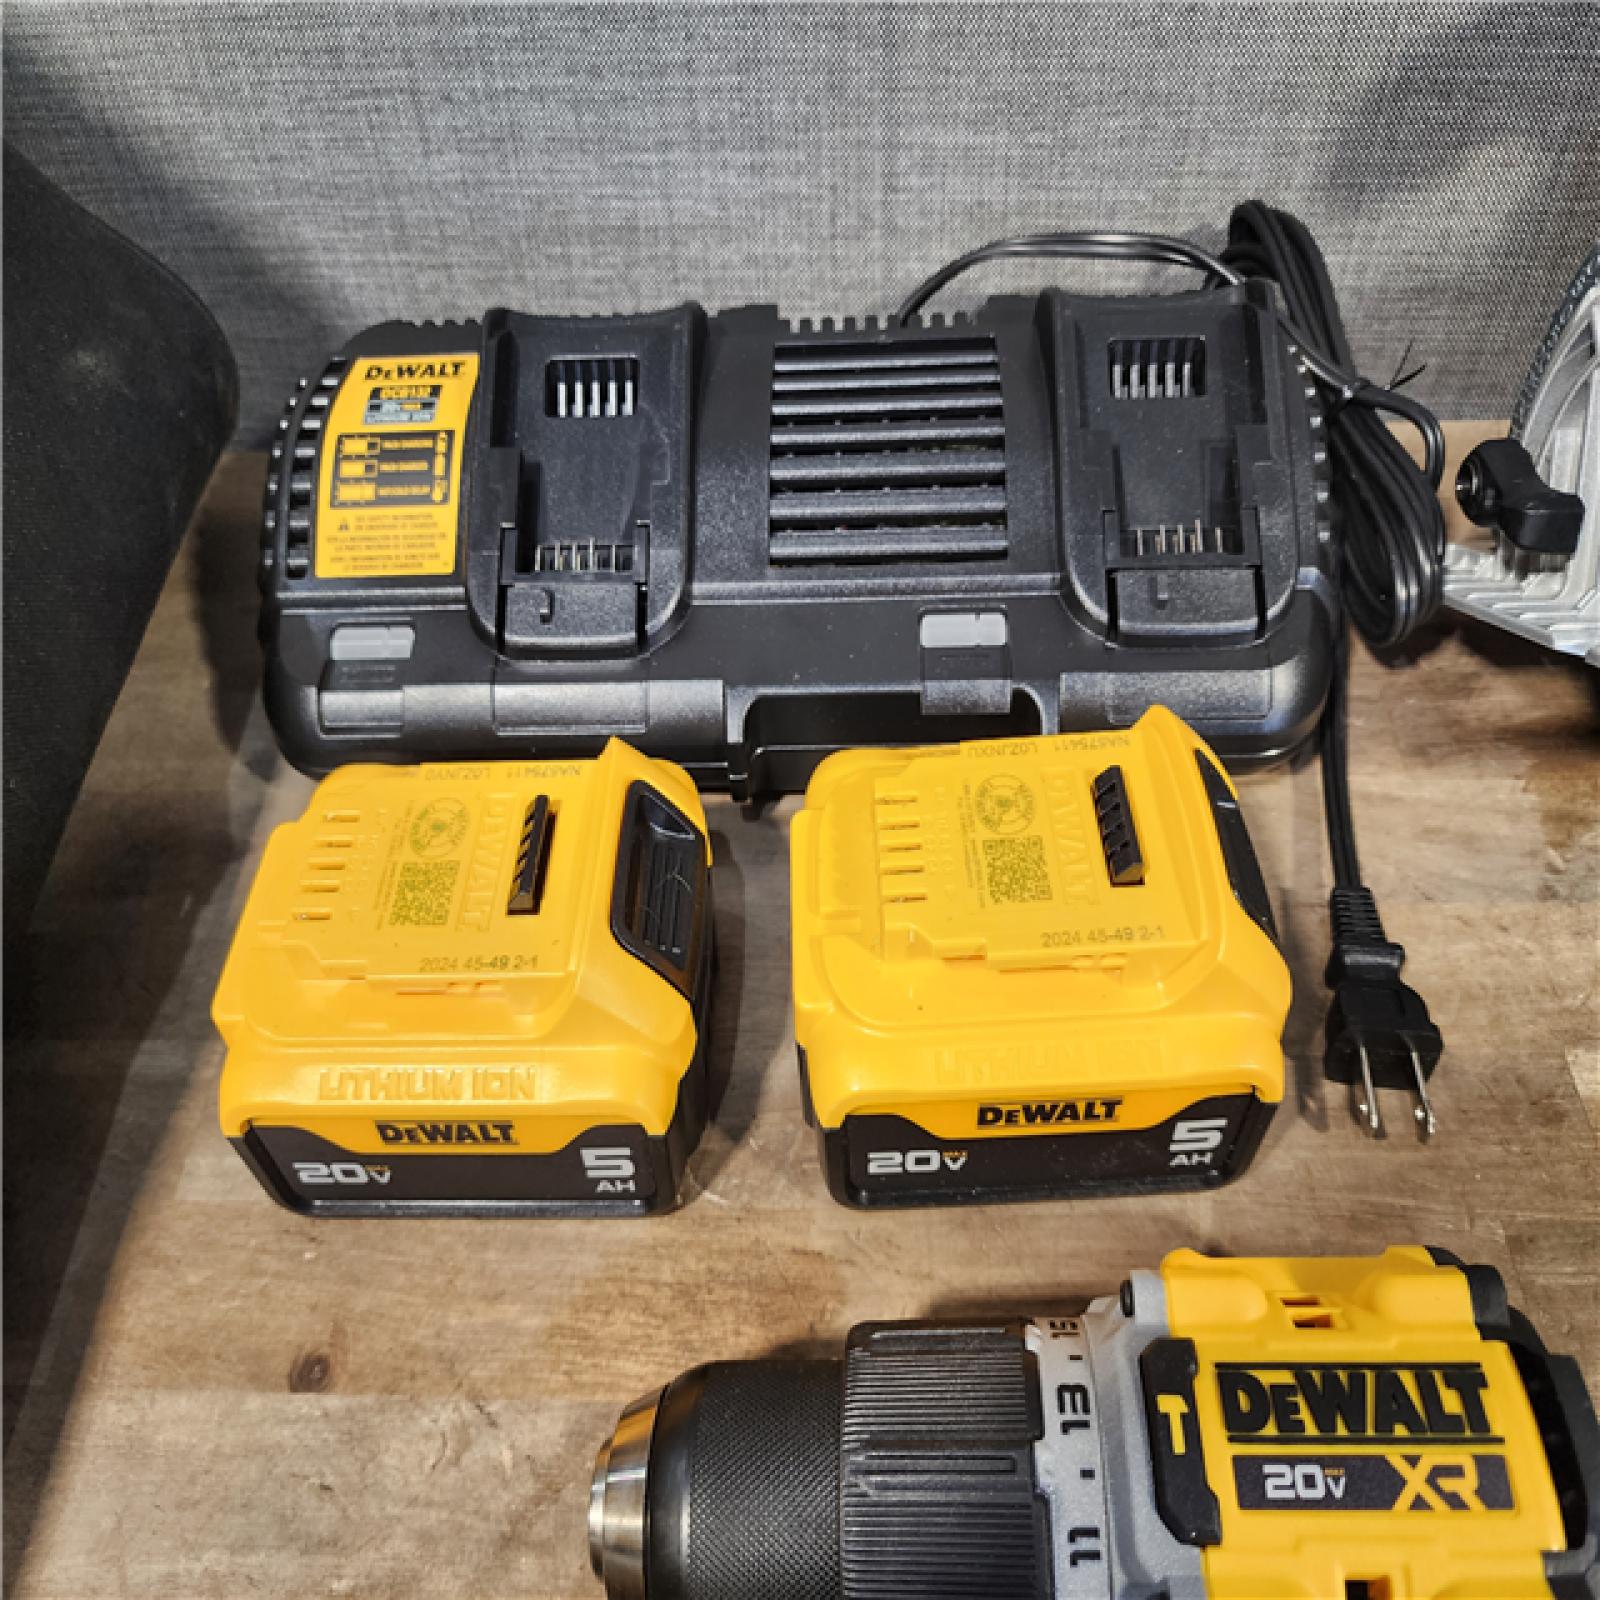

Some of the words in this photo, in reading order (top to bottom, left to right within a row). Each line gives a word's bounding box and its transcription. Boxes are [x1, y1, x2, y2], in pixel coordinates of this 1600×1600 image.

[364, 361, 466, 380] DEWALT
[1041, 932, 1081, 947] 2024
[420, 957, 459, 971] 2024
[319, 1068, 463, 1101] LITHIUM
[471, 1066, 536, 1100] ION
[977, 1099, 1123, 1127] DEWALT
[376, 1120, 516, 1144] DEWALT
[1169, 1119, 1228, 1152] 5
[580, 1147, 636, 1178] 5
[1169, 1151, 1213, 1167] AH
[596, 1179, 636, 1193] AH
[1049, 1319, 1081, 1340] 15
[1056, 1383, 1091, 1435] 13
[1217, 1368, 1493, 1435] DEWALT
[1384, 1454, 1486, 1511] XR
[1068, 1526, 1100, 1568] 11
